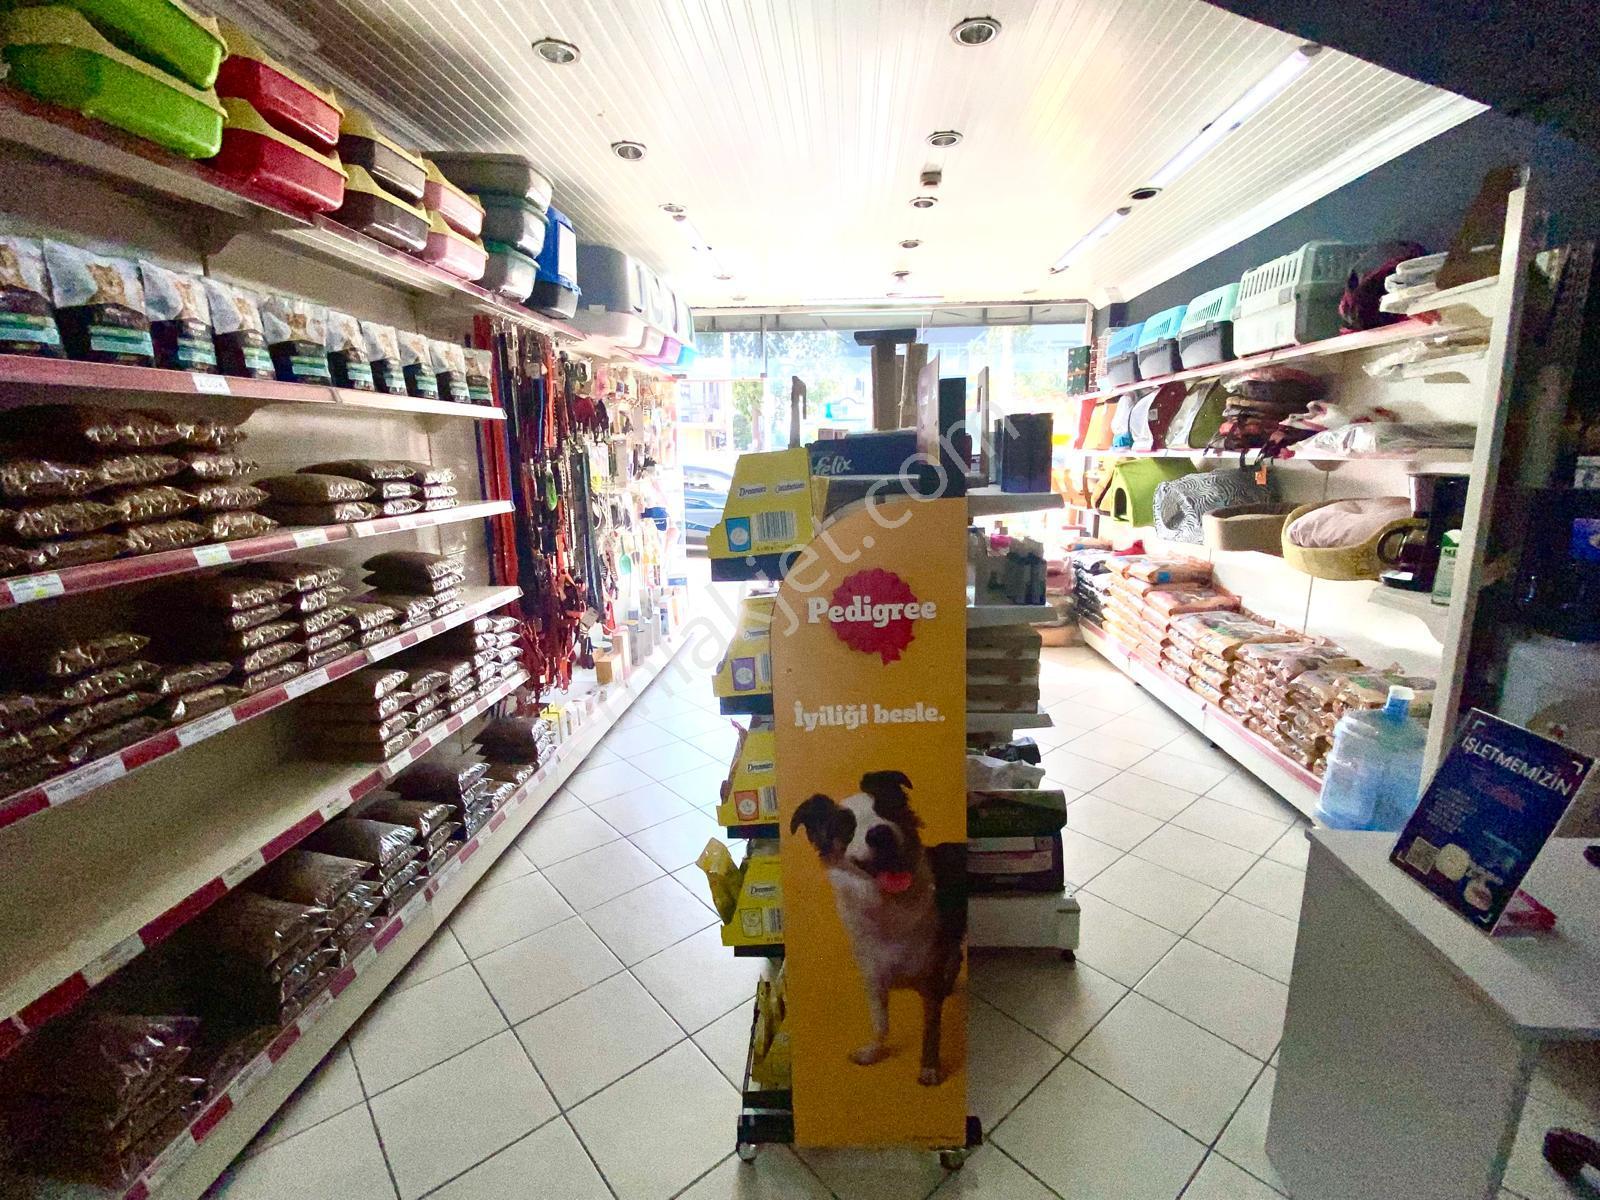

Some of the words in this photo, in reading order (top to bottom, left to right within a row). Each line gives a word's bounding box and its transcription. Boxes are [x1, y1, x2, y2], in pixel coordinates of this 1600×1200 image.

[807, 595, 937, 628] Pedigree
[794, 700, 869, 732] İyiliği
[873, 702, 945, 724] besle.
